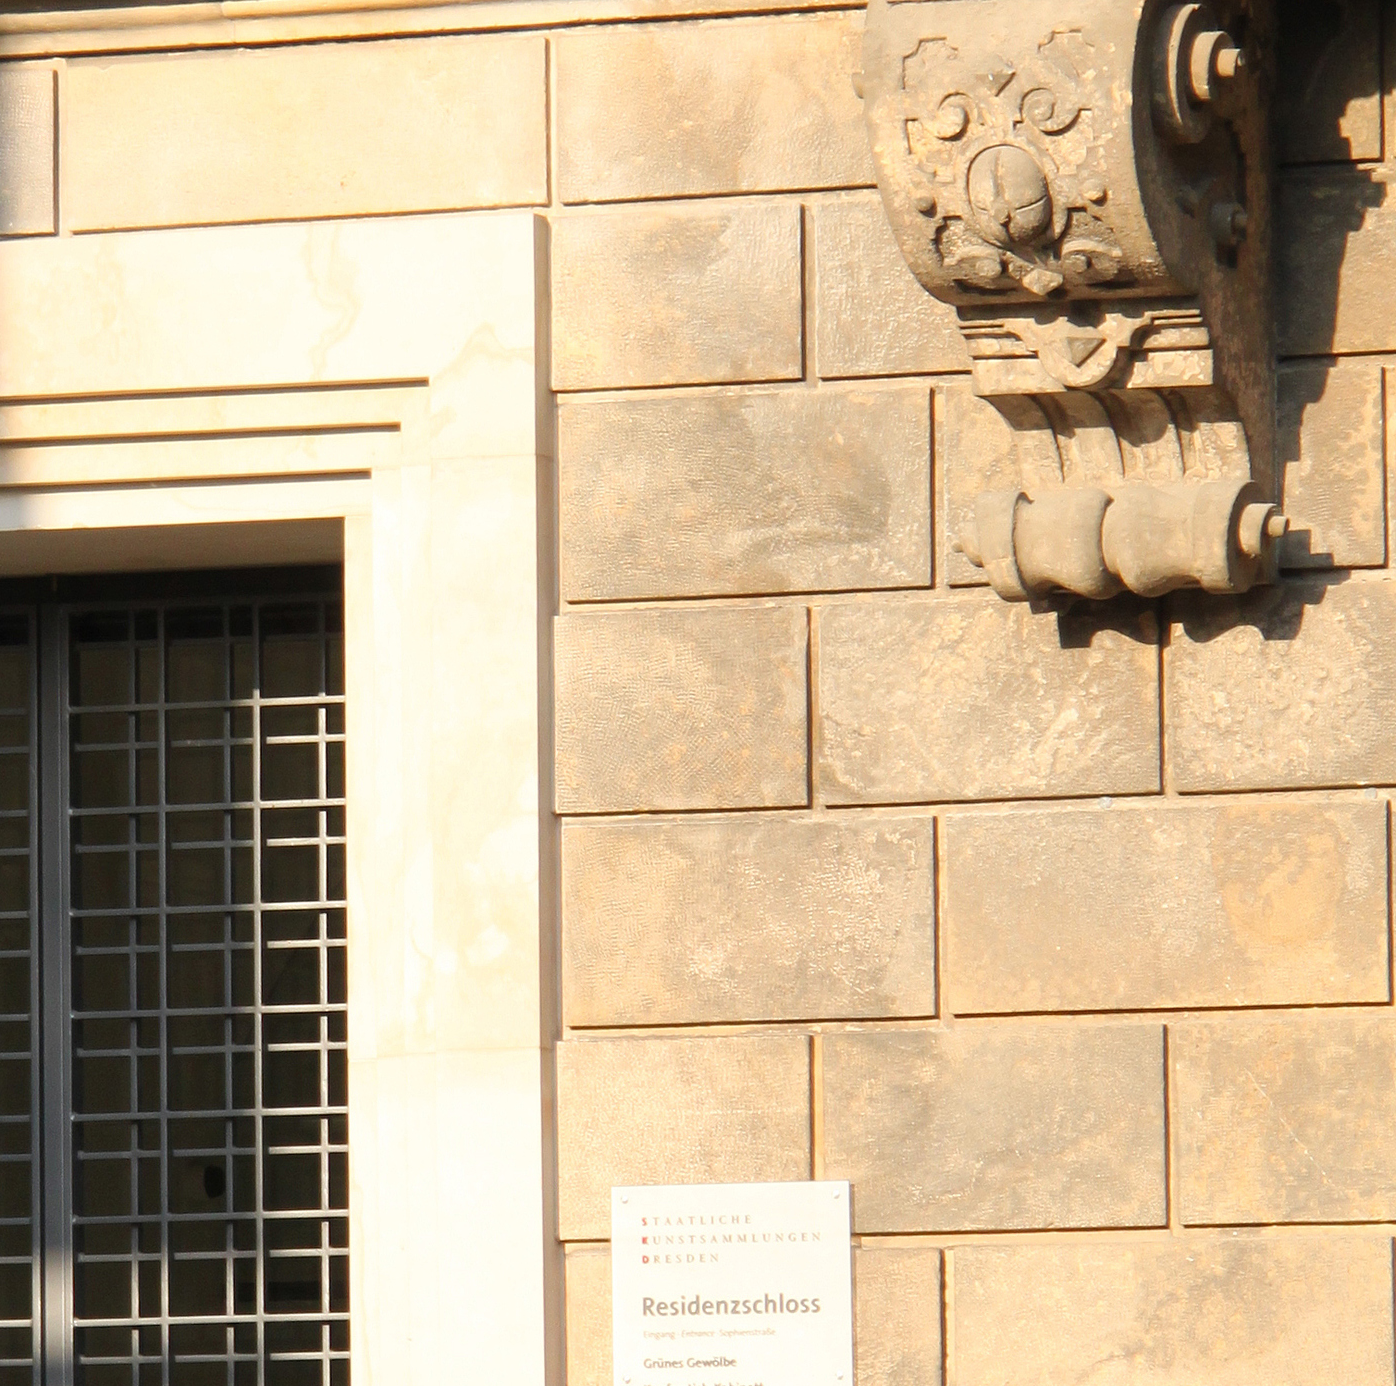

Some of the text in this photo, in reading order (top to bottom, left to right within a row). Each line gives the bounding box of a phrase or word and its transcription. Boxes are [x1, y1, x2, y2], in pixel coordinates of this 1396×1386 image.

[641, 1215, 752, 1227] STAATLICHE
[641, 1232, 821, 1245] KUNSTSAMMLUNGEN
[641, 1253, 720, 1265] DRESDEN
[642, 1292, 821, 1317] Residenzschloss
[643, 1356, 738, 1369] Grünes Gewölbe
